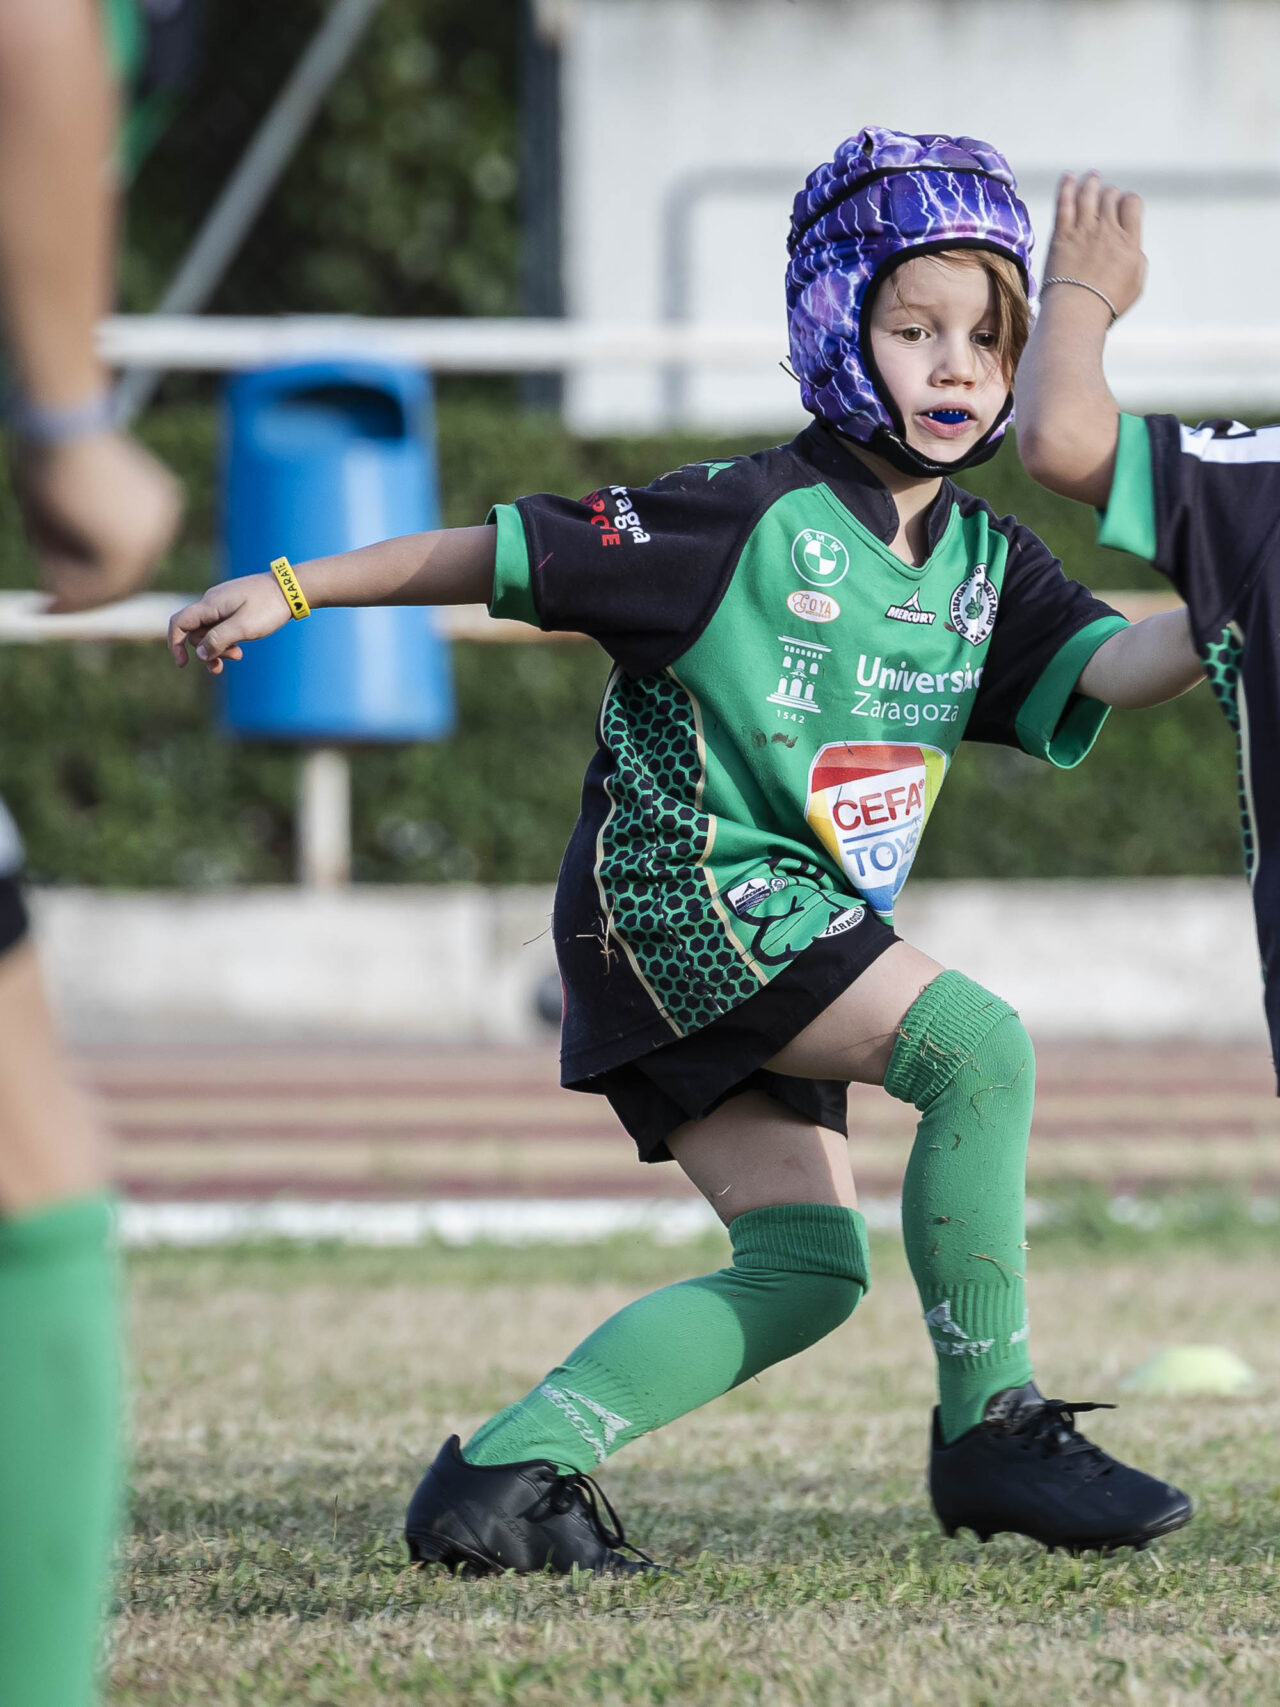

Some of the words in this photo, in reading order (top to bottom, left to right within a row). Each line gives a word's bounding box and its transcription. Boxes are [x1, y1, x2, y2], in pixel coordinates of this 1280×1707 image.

[803, 532, 841, 552] BMW
[275, 562, 300, 601] KARATE
[886, 606, 936, 624] MERCURY
[776, 709, 805, 724] 1542
[850, 690, 959, 727] Zaragoza
